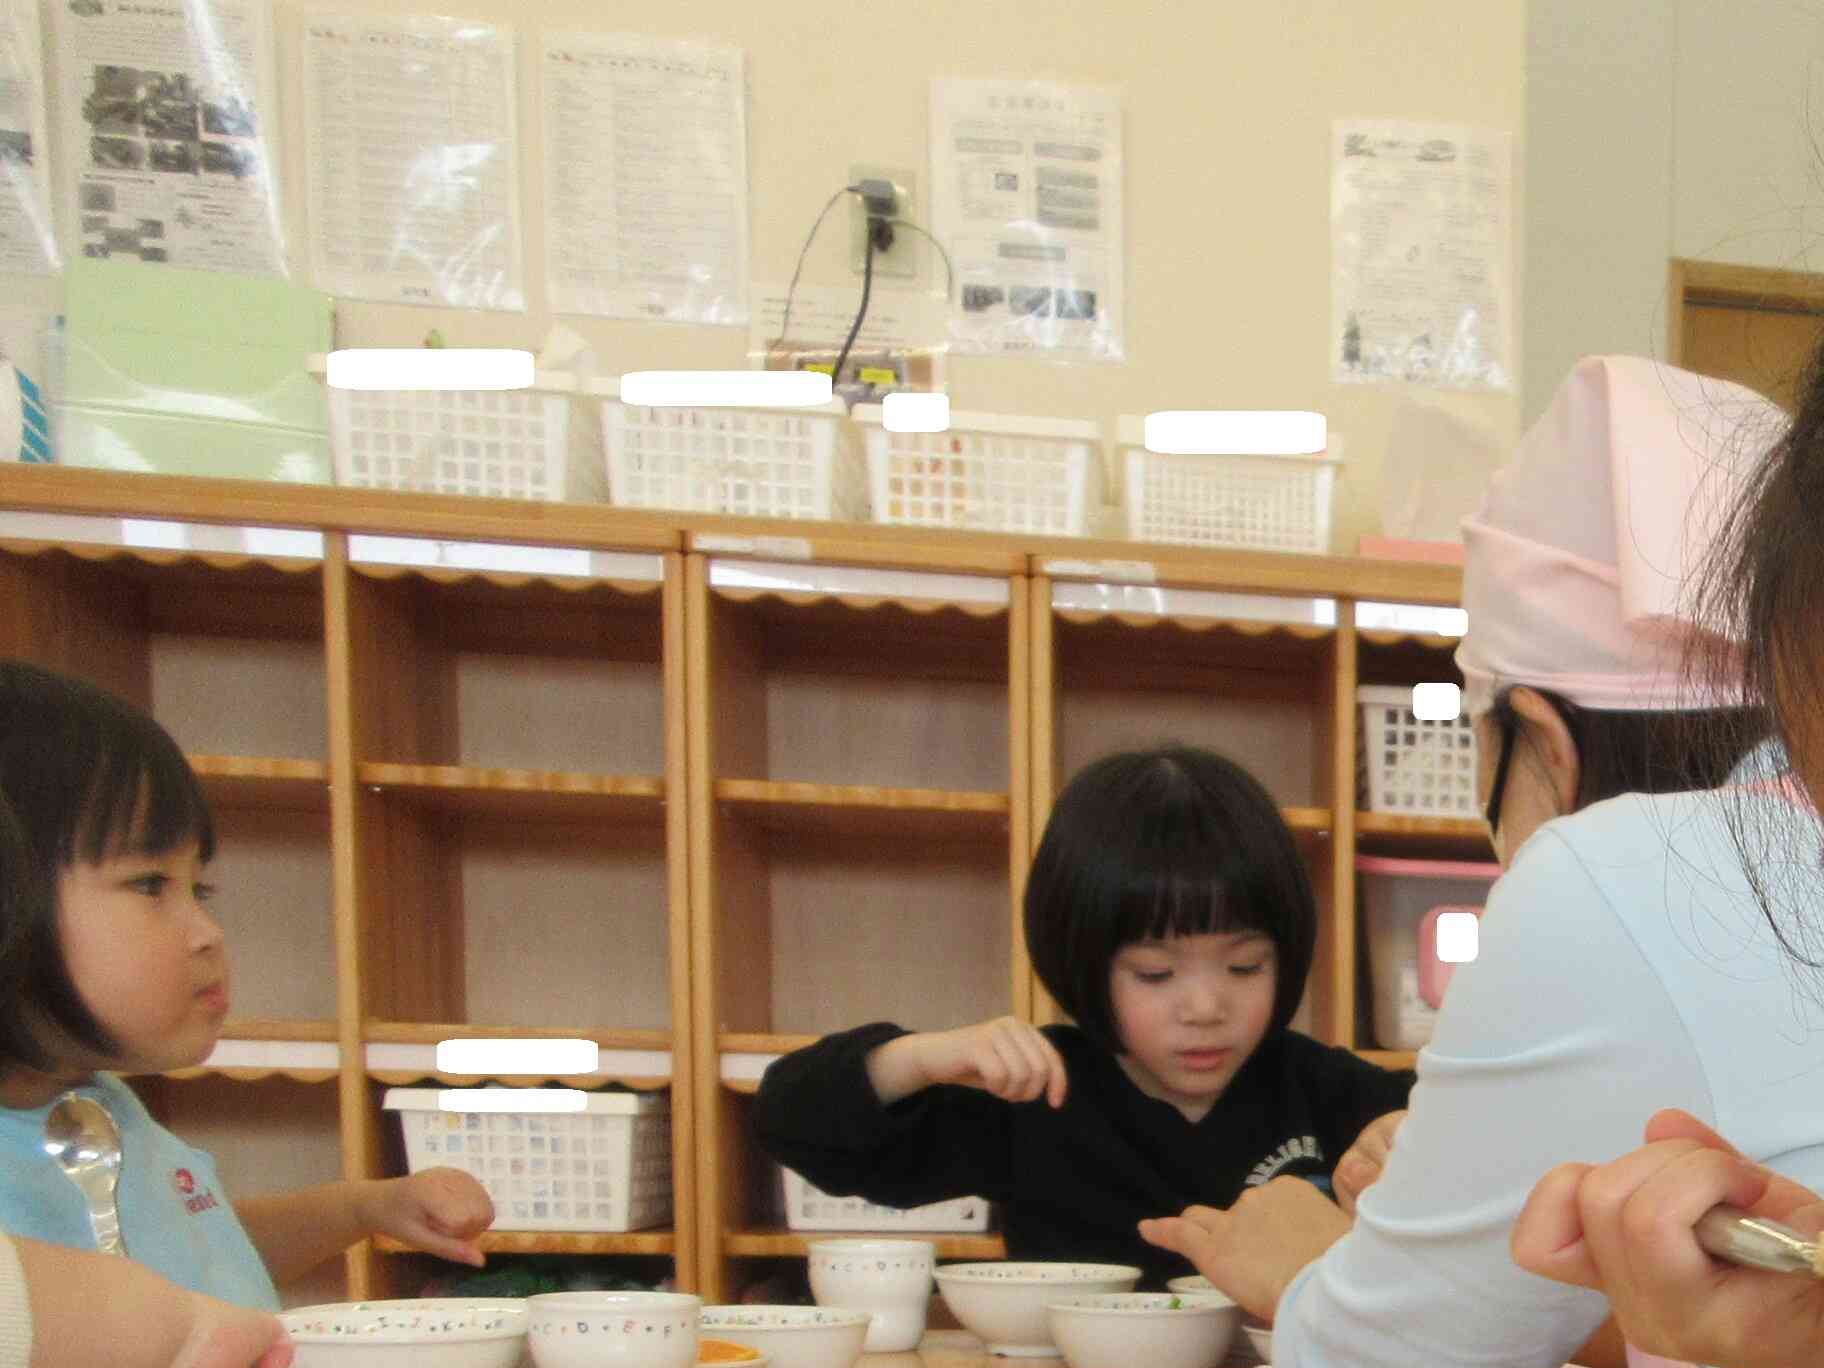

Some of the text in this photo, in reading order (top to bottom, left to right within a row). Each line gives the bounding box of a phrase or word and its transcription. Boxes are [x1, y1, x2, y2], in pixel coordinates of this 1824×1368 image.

[576, 1322, 589, 1334] D
[624, 1321, 637, 1334] E
[663, 1325, 671, 1338] F
